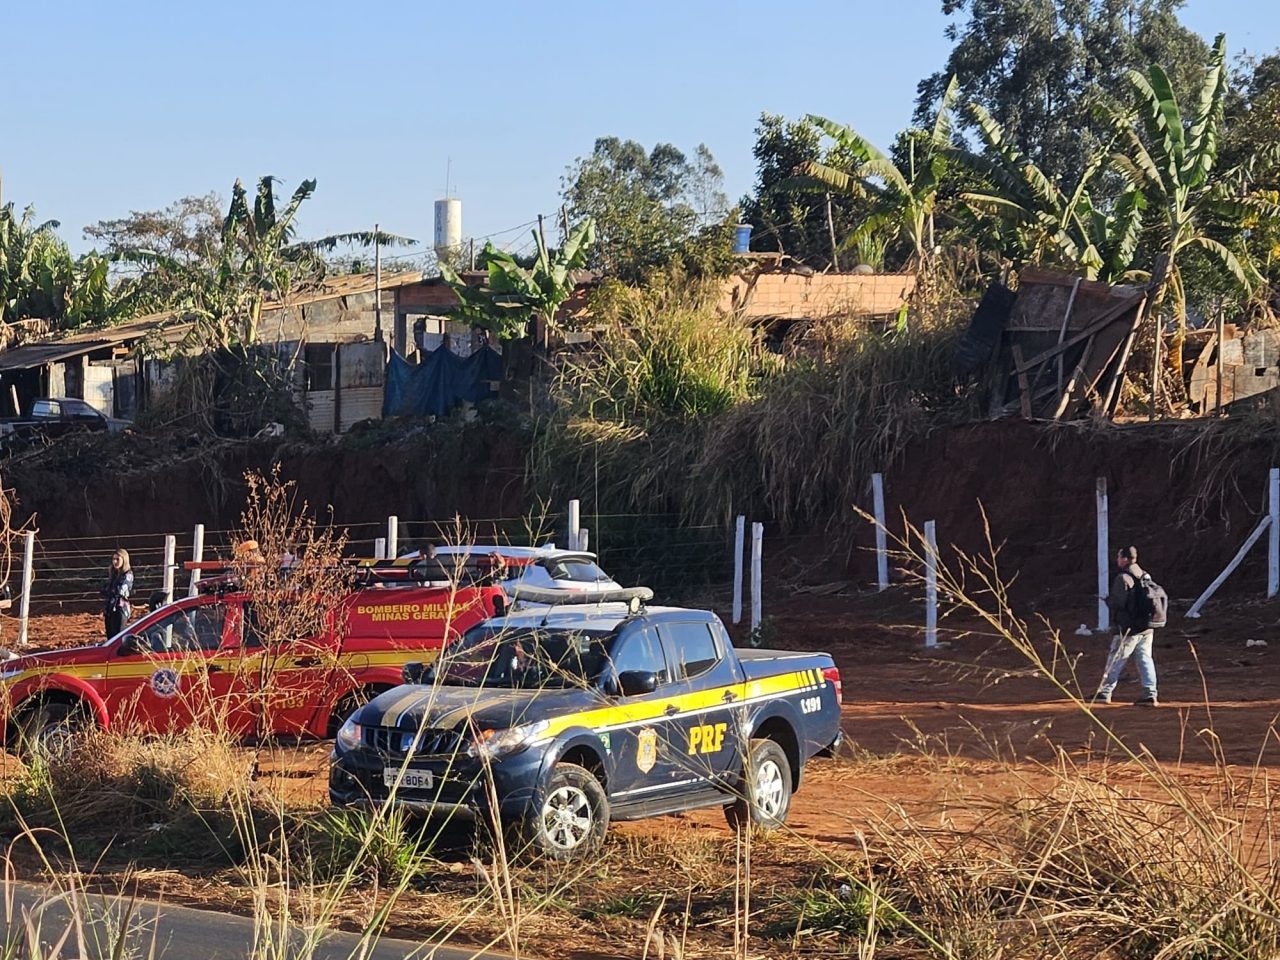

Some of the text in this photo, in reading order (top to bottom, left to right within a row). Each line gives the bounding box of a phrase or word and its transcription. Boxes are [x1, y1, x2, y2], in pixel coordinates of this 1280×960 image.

[357, 604, 420, 614] BOMBEIRO
[371, 612, 410, 621] MINAS
[805, 696, 822, 713] 191
[688, 723, 727, 755] PRF
